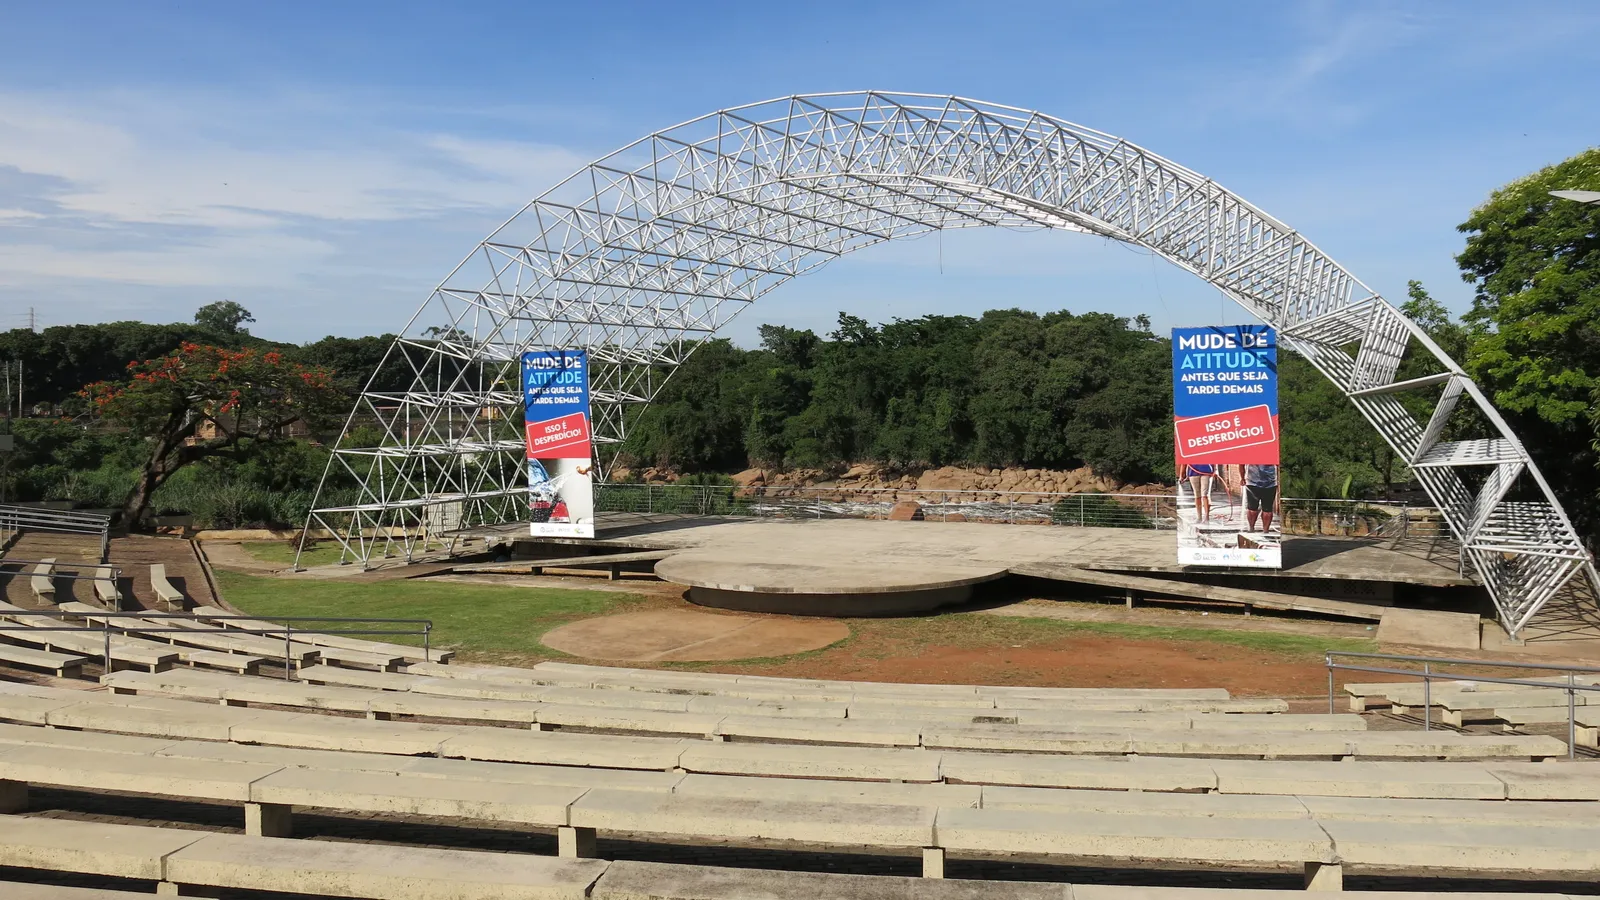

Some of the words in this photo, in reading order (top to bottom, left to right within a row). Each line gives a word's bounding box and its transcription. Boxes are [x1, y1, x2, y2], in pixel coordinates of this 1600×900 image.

[1179, 333, 1236, 350] MUDE
[1242, 332, 1268, 348] DE
[526, 356, 562, 370] MUDE
[564, 355, 582, 369] DE
[1180, 351, 1268, 370] ATITUDE
[528, 371, 583, 385] ATITUDE
[1181, 372, 1215, 382] ANTES
[1217, 372, 1240, 382] QUE
[1242, 371, 1268, 381] SEJA
[528, 387, 549, 395] ANTES
[566, 386, 583, 394] SEJA
[1186, 385, 1221, 395] TARDE
[1222, 384, 1264, 394] DEMAIS
[532, 397, 553, 405] TARDE
[554, 396, 580, 404] DEMAIS
[544, 424, 561, 434] ISSO
[562, 420, 567, 430] É
[1205, 419, 1231, 433] ISSO
[1234, 415, 1241, 427] É
[534, 428, 582, 446] DESPERDÍCIO!
[1187, 425, 1265, 449] DESPERDÍCIO!
